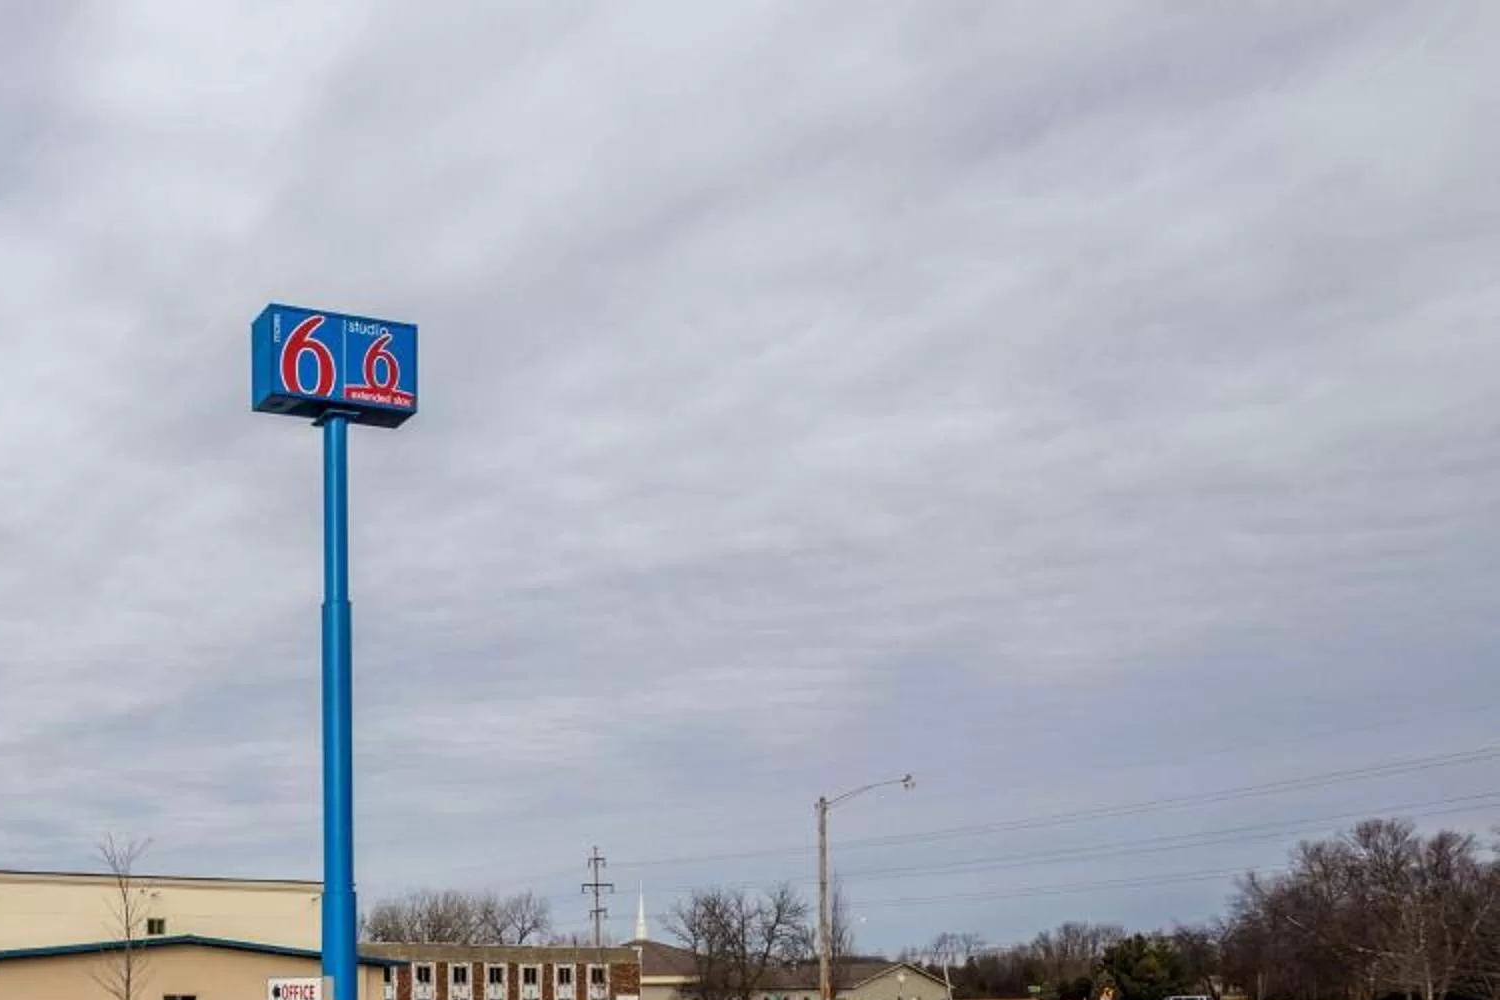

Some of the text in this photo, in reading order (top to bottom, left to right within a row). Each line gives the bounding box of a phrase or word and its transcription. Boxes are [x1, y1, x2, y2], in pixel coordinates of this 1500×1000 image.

[348, 321, 389, 336] studio
[280, 315, 337, 397] 6
[363, 333, 401, 391] 6
[282, 984, 315, 1000] OFFICE
